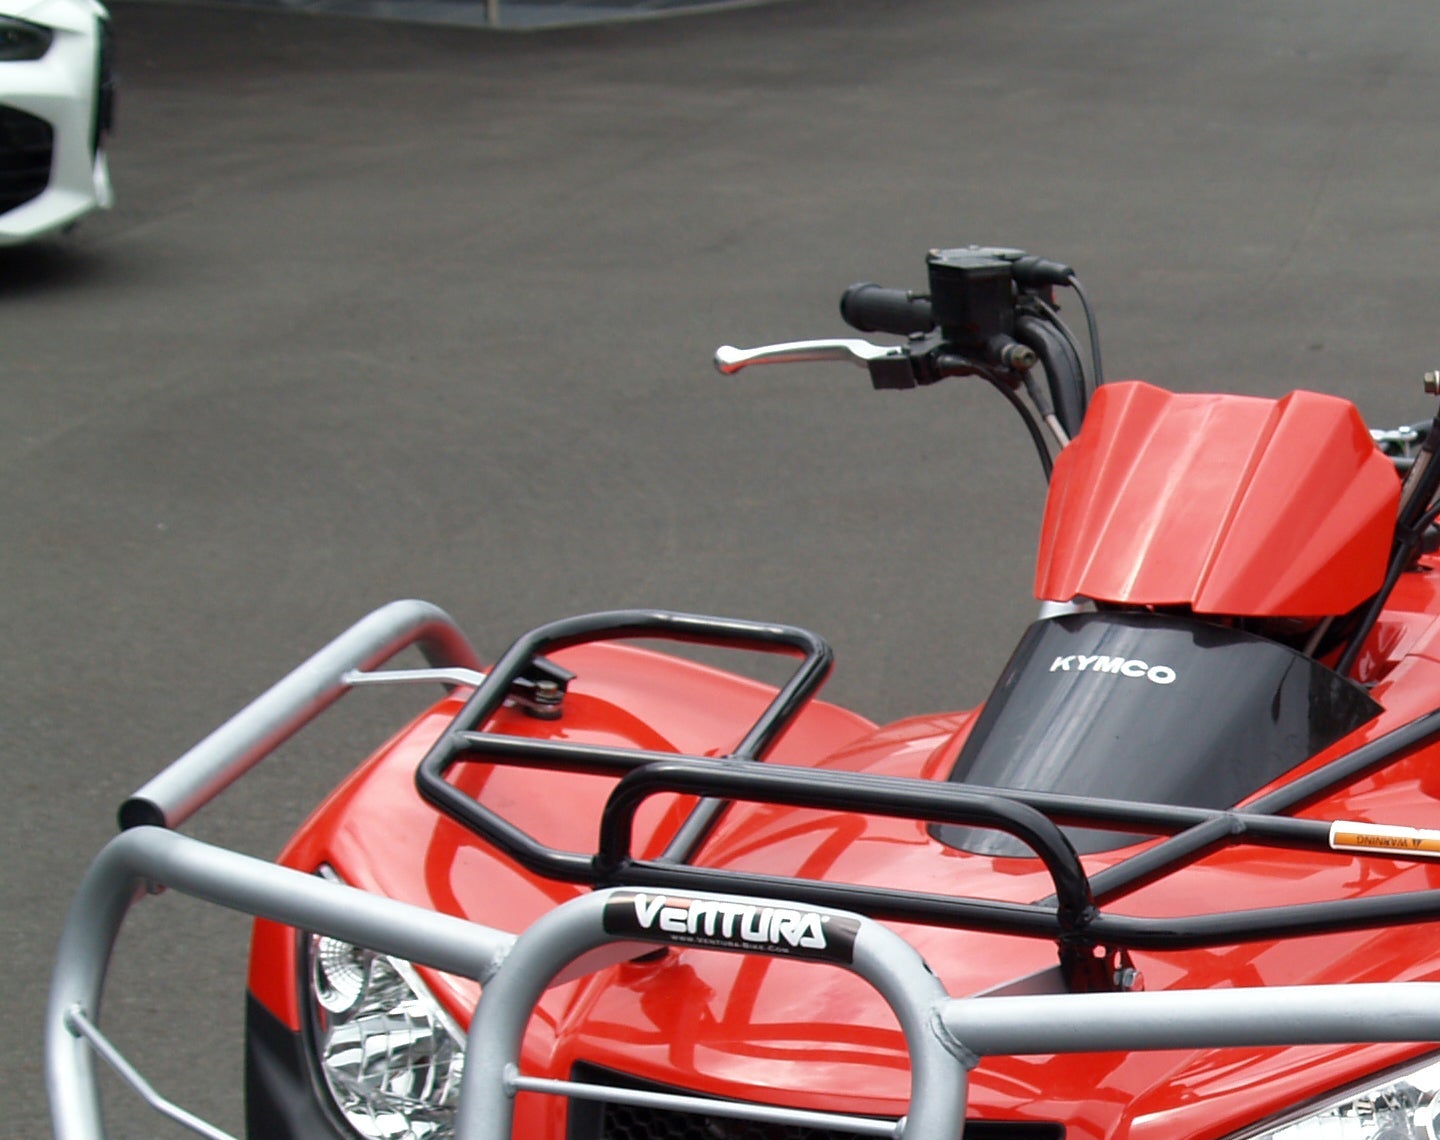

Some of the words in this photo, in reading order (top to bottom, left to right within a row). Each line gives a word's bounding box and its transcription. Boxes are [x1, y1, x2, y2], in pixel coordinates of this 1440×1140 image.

[1049, 655, 1176, 684] KYMCO
[1356, 834, 1409, 848] WARNING
[633, 893, 827, 949] VENTURA
